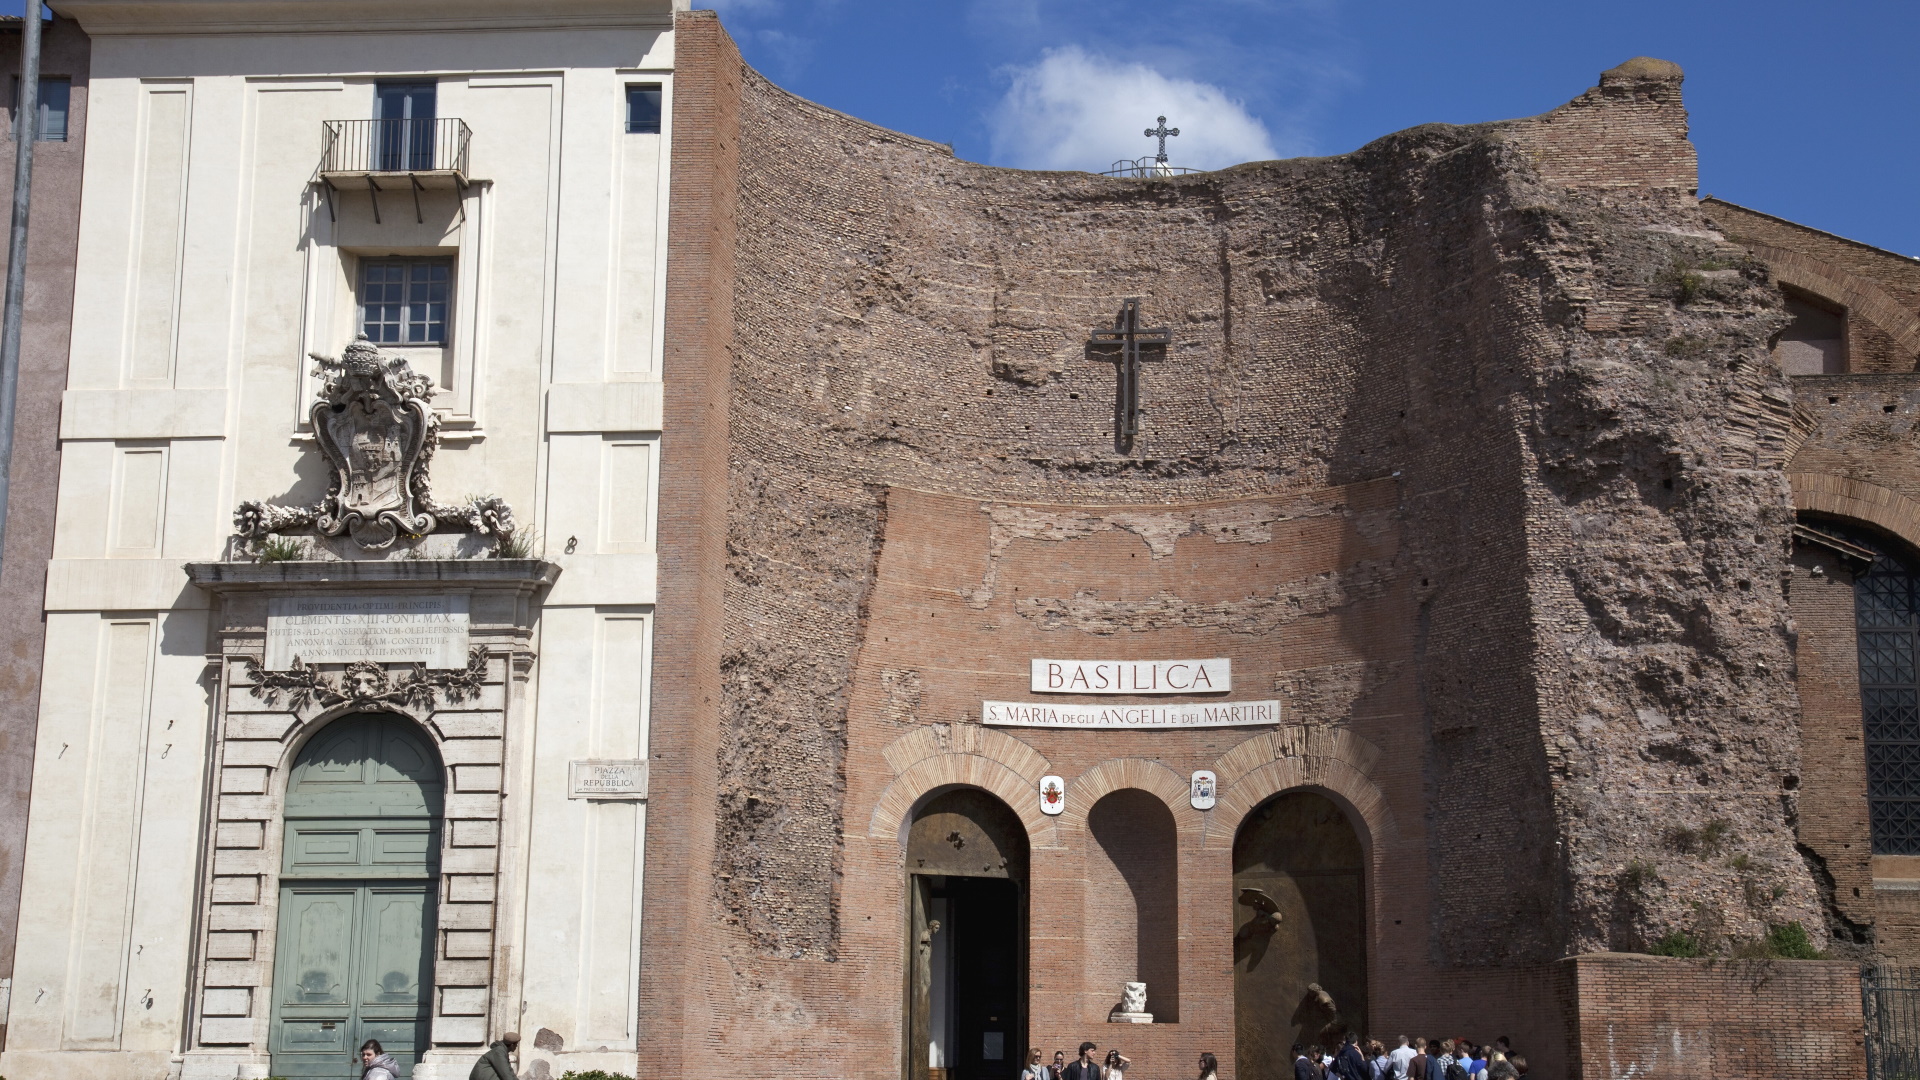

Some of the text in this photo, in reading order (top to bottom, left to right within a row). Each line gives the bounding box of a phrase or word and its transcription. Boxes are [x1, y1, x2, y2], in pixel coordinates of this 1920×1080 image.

[297, 603, 358, 611] PROVIDENTIA
[362, 602, 394, 610] OPTIMI
[285, 613, 451, 625] CLEMENTIS XIII PONT MAX
[270, 628, 301, 636] PUTEIS
[306, 628, 320, 636] AD
[287, 638, 333, 646] ANNONAM
[1048, 663, 1213, 690] BASILICA
[989, 705, 1273, 724] S. MARIA DEGLI ANGELI E DEI MARTIRI
